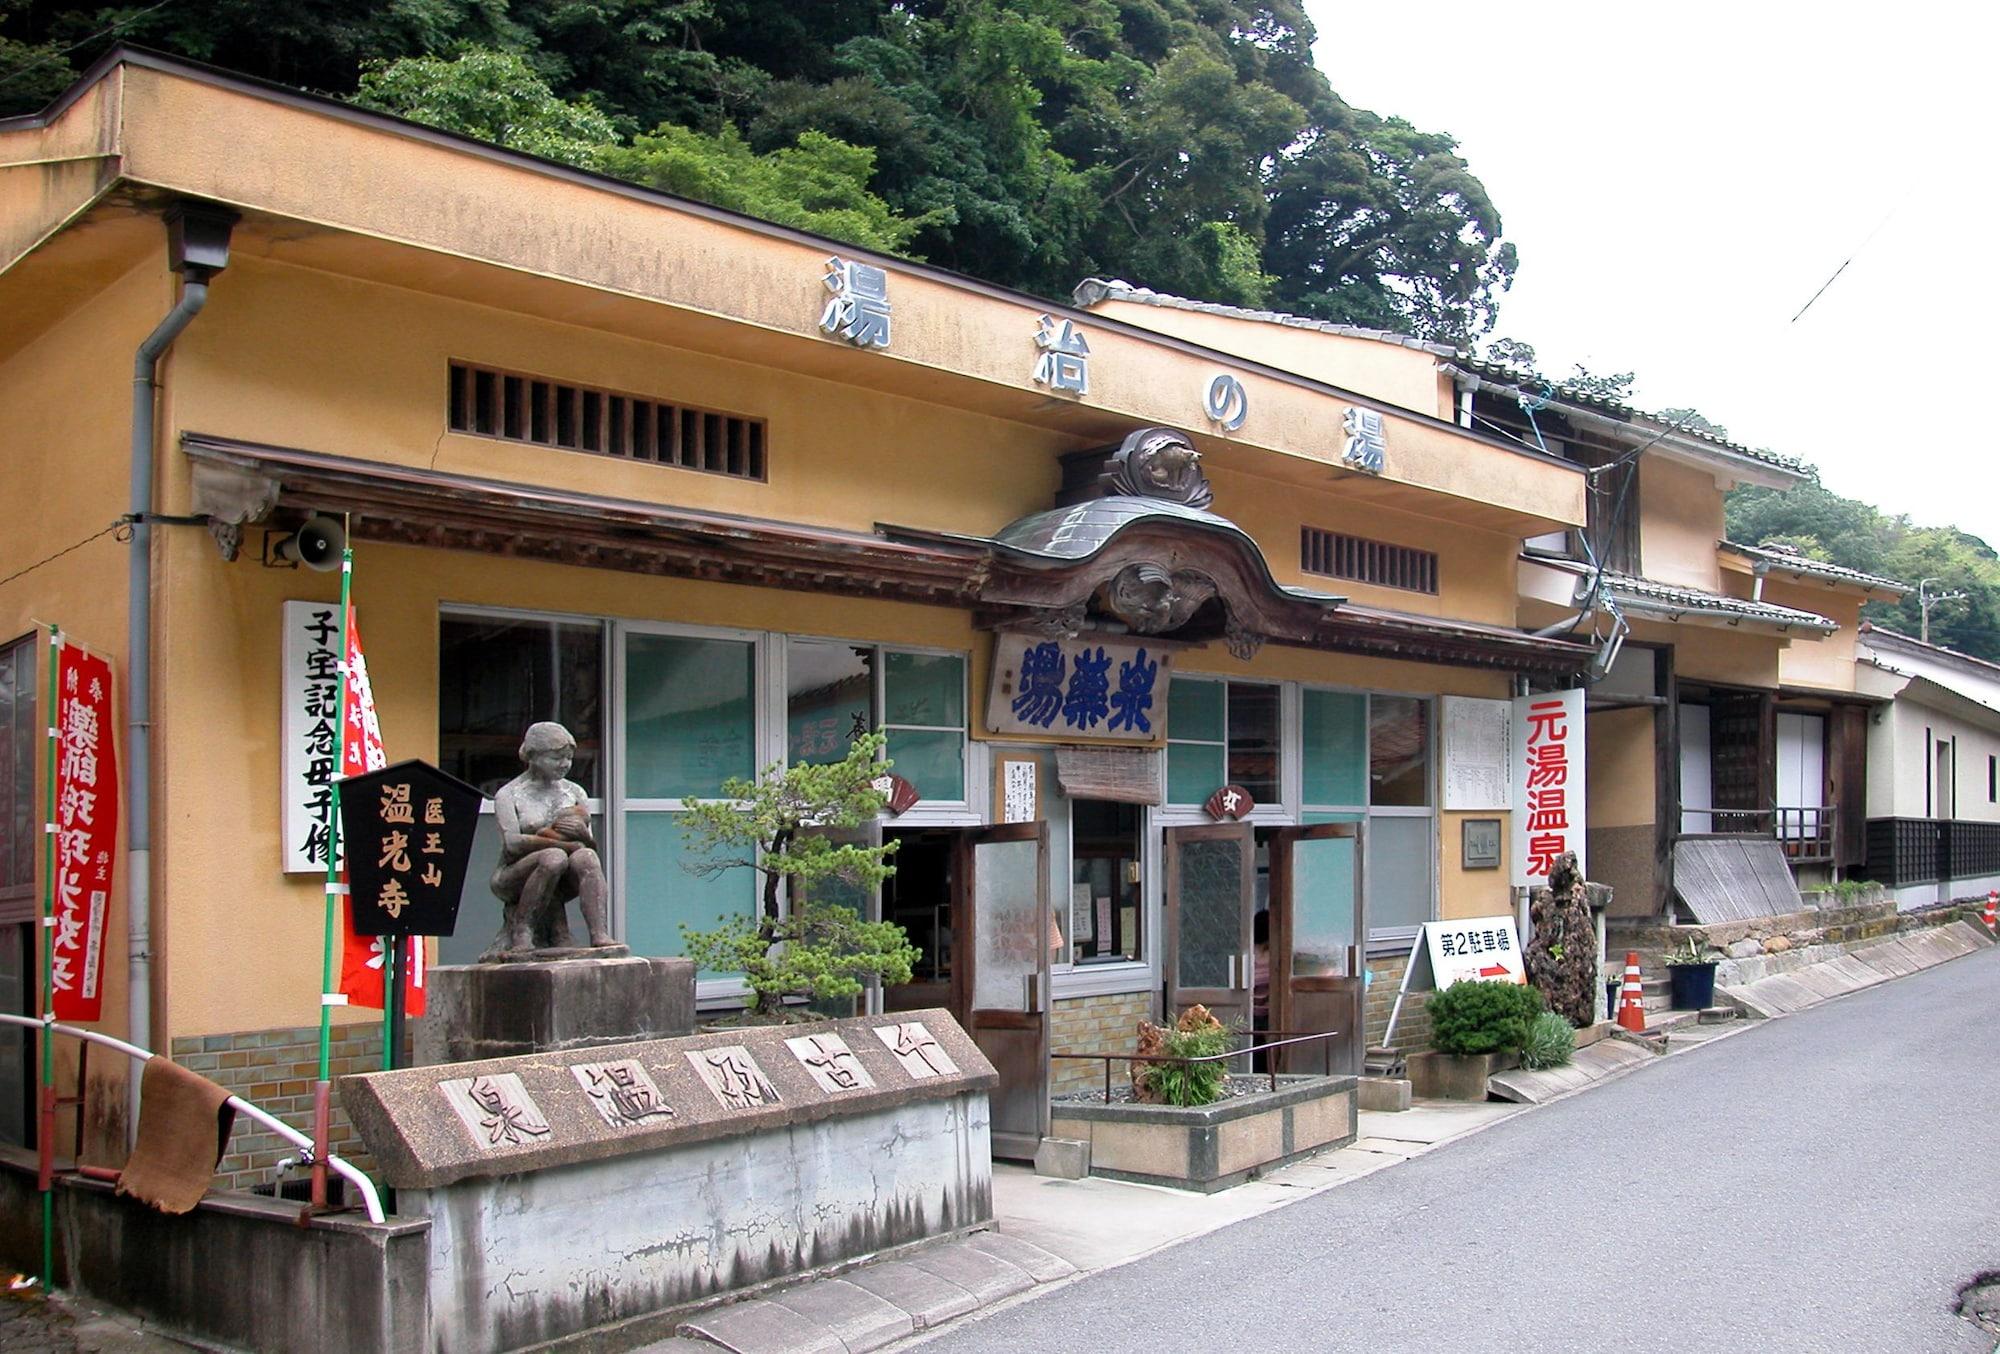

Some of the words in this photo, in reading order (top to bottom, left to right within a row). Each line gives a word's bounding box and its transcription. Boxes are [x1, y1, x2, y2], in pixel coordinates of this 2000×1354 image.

[1223, 790, 1242, 811] 女
[1525, 700, 1569, 876] 元湯温泉
[378, 783, 415, 918] 温光寺
[420, 797, 445, 887] 医王山
[1440, 928, 1510, 957] 第2駐車場
